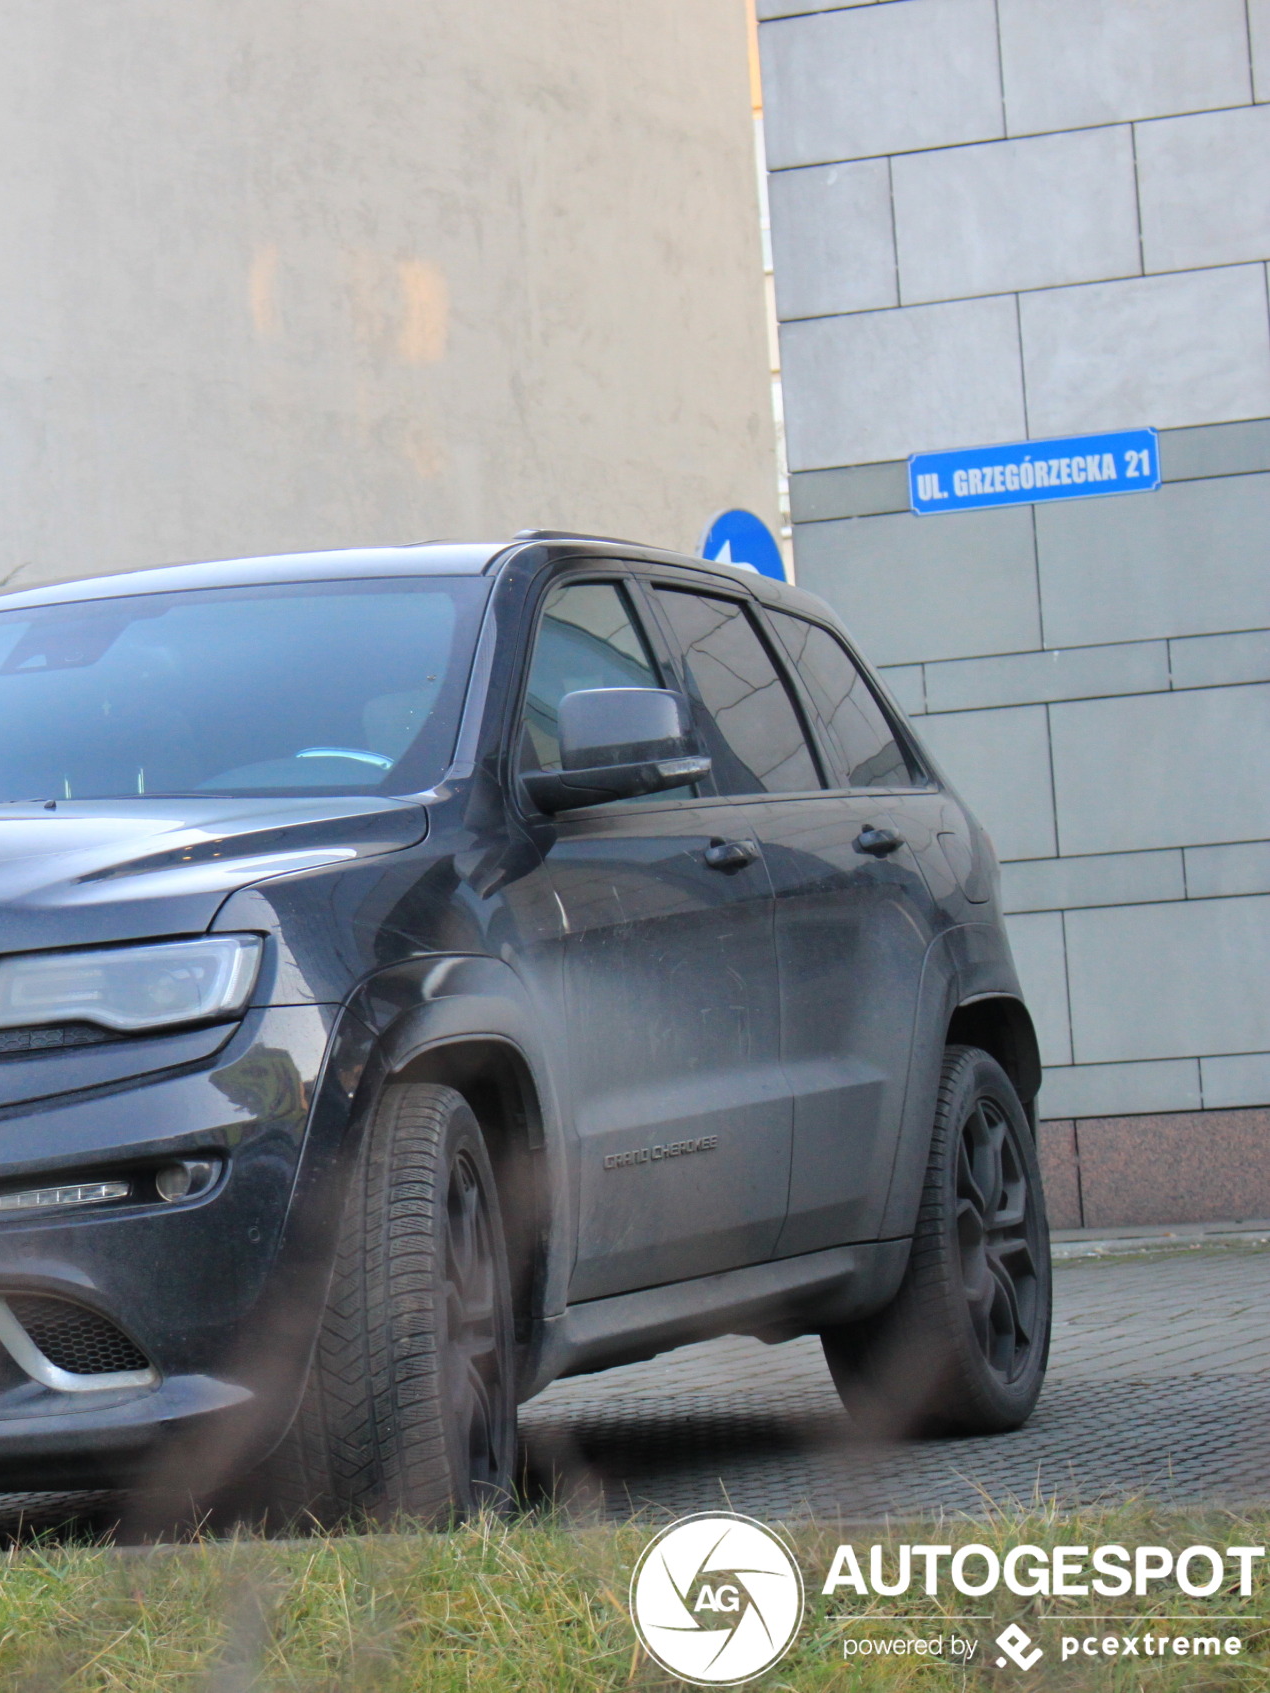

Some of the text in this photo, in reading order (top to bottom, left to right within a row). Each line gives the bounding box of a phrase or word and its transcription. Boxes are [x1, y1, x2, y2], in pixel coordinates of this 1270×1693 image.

[917, 449, 1150, 501] UL. GRZEGÓRZECKA 21
